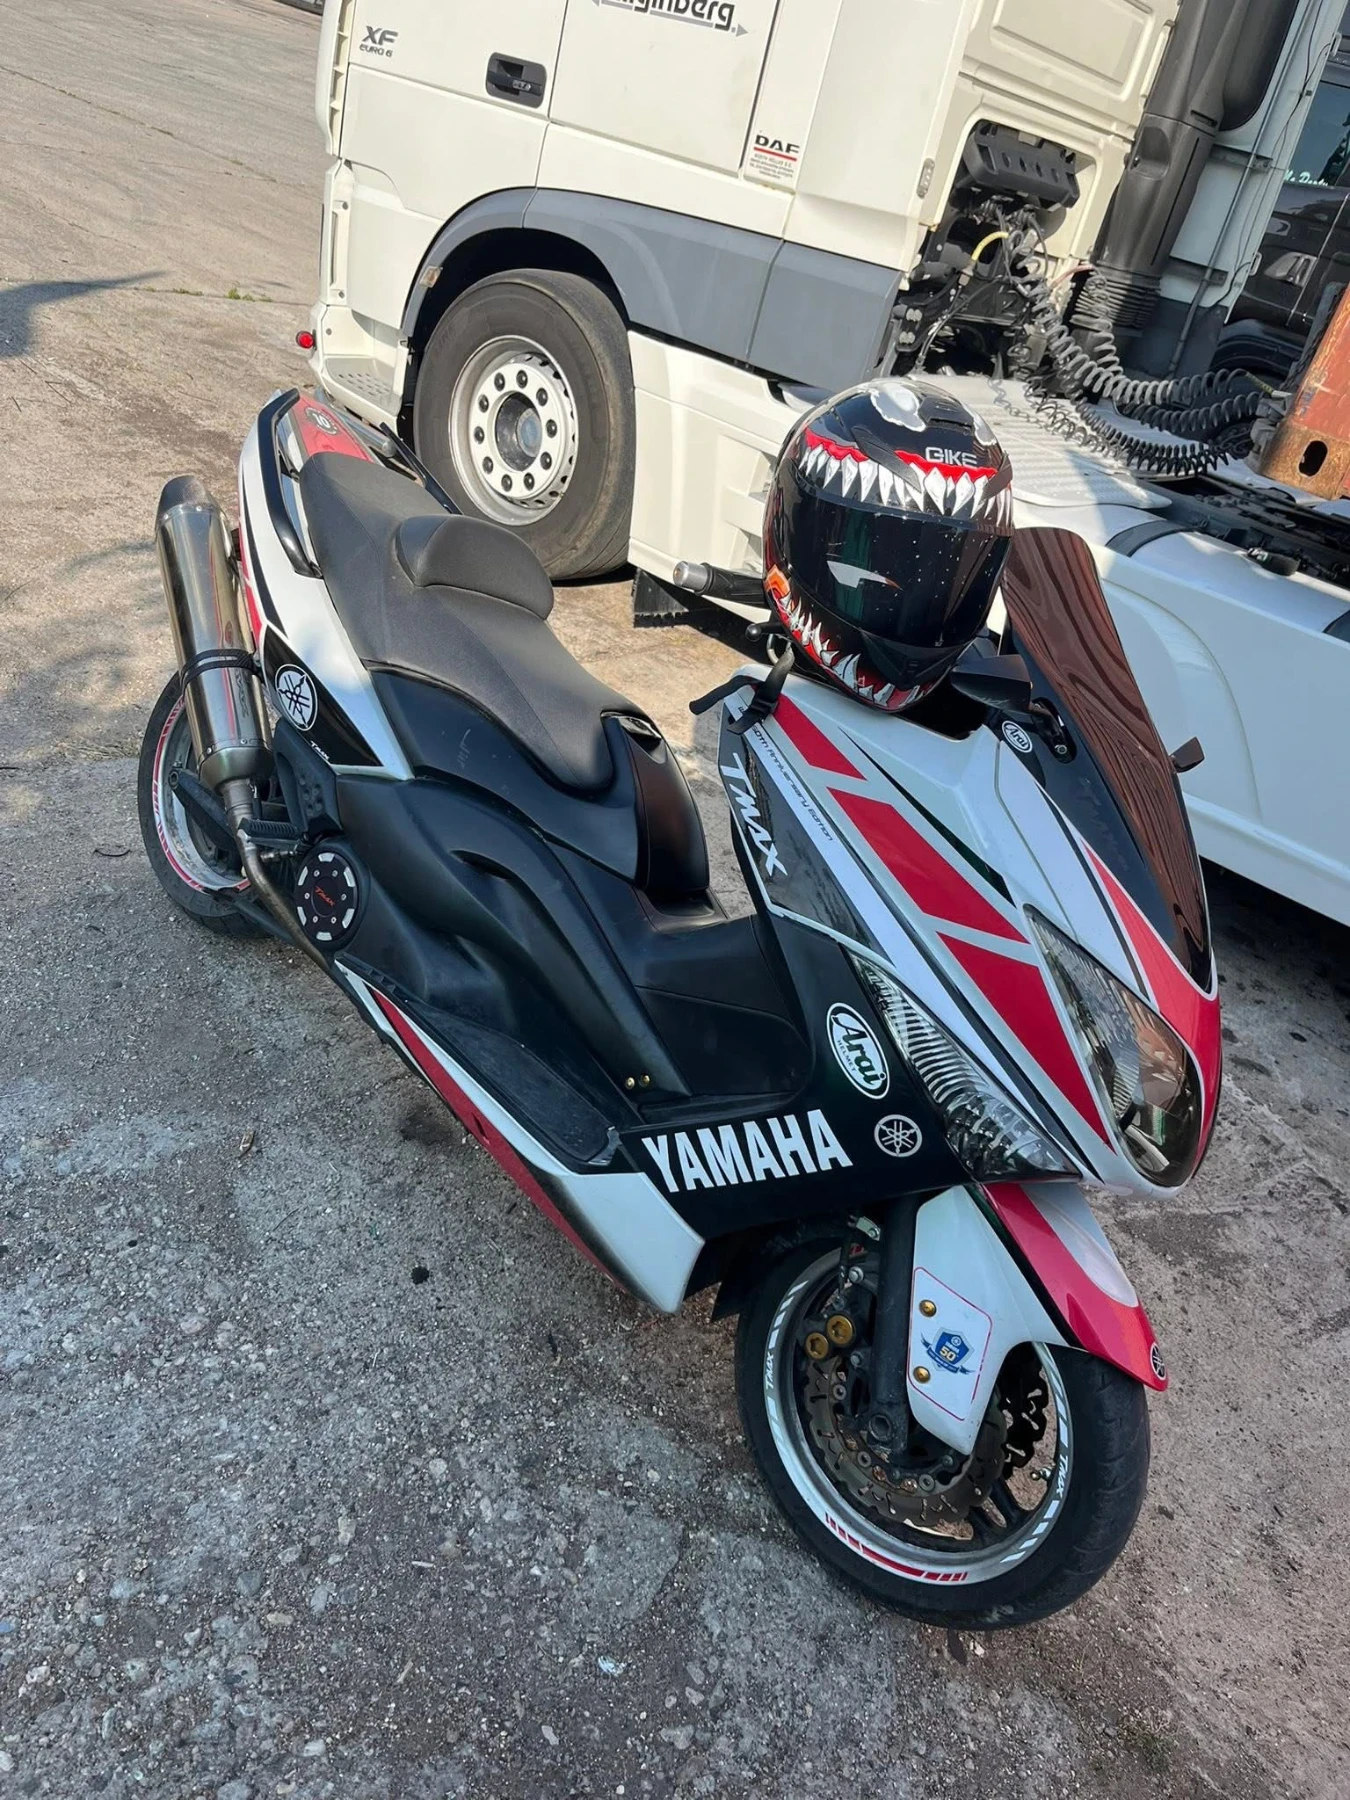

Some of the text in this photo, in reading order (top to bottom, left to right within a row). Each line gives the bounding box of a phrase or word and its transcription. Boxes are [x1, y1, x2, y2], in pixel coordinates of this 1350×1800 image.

[361, 25, 399, 46] XF
[385, 49, 394, 58] 6
[755, 134, 800, 154] DAF
[1003, 724, 1030, 749] Arai
[768, 745, 810, 808] Anniversary
[807, 808, 833, 841] Edition
[719, 752, 788, 877] TMAX
[831, 1013, 886, 1086] Arai
[836, 1039, 857, 1074] HELMET
[641, 1109, 853, 1193] YAMAHA
[939, 1345, 957, 1362] 50
